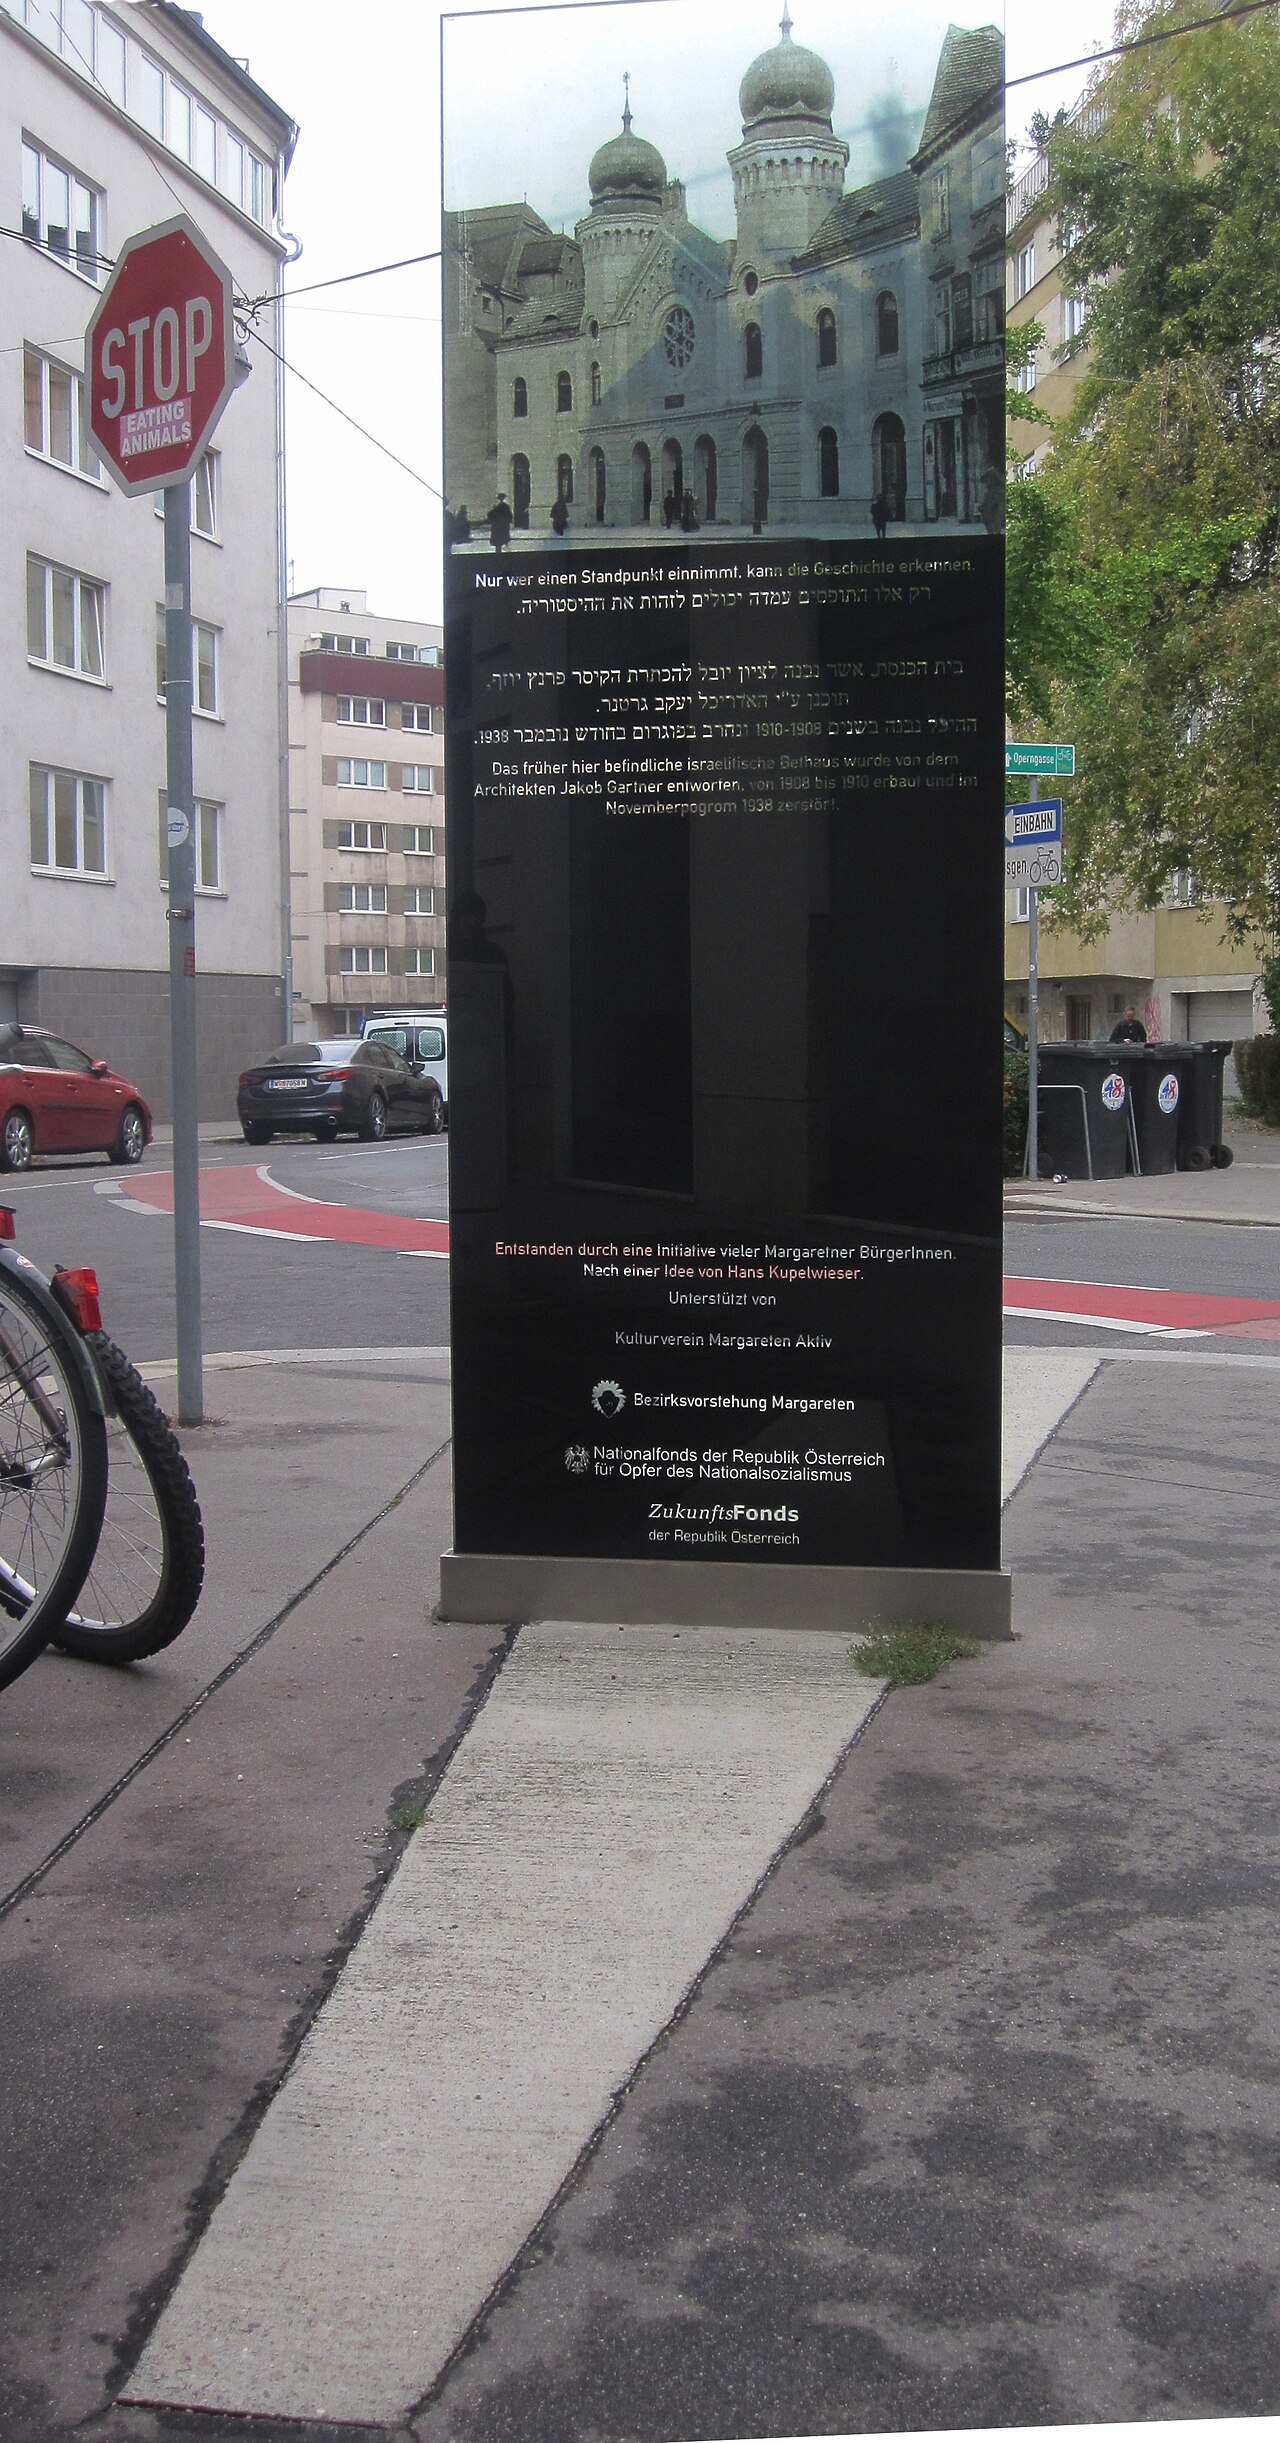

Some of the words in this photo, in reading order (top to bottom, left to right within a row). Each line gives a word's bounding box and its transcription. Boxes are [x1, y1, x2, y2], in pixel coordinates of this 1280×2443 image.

[101, 296, 213, 419] STOP
[127, 400, 184, 432] EATING
[120, 421, 191, 456] ANIMALS
[475, 573, 503, 588] Nur
[507, 574, 533, 586] wer
[538, 570, 577, 585] einen
[581, 566, 665, 586] Standpunkt
[747, 564, 783, 578] kann
[788, 562, 809, 576] die
[814, 559, 895, 576] Geschichte
[899, 559, 975, 572] erkennen.
[611, 596, 634, 611] את
[639, 590, 685, 609] לזהות
[692, 588, 742, 608] יכולים
[749, 590, 791, 607] עמדה
[909, 586, 932, 604] רק
[516, 596, 605, 614] ההיסטוריה.
[572, 670, 621, 688] הקיסר
[627, 663, 692, 684] להכתרת
[698, 662, 732, 681] יובל
[738, 660, 778, 683] לציון
[784, 664, 820, 678] נבנה
[827, 662, 863, 678] אשר
[527, 671, 566, 690] פרנץ
[596, 697, 649, 712] גרטנר.
[654, 695, 692, 714] יעקב
[698, 691, 768, 711] האדריכל
[513, 728, 569, 743] נובמבר
[575, 726, 626, 742] בחודש
[829, 720, 879, 735] בשנים
[886, 719, 921, 734] נבנה
[493, 762, 519, 776] Das
[523, 761, 568, 775] früher
[572, 760, 600, 774] hier
[605, 758, 683, 773] befindliche
[687, 756, 775, 771] israelitische
[780, 755, 839, 769] Bethaus
[844, 753, 891, 767] wurde
[896, 755, 921, 767] von
[927, 752, 959, 766] dem
[1013, 752, 1055, 767] Operngasse
[474, 782, 555, 797] Architekten
[560, 780, 603, 795] Jakob
[607, 779, 663, 794] Gartner
[750, 780, 775, 791] von
[780, 776, 810, 790] 1908
[815, 776, 836, 789] bis
[842, 775, 869, 789] 1910
[926, 773, 954, 787] und
[606, 800, 737, 817] Novemberpogrom
[742, 798, 773, 813] 1938
[1014, 811, 1053, 834] EINBAHN
[495, 1242, 573, 1256] Entstanden
[578, 1242, 618, 1257] durch
[623, 1243, 653, 1257] eine
[657, 1243, 716, 1258] Initiative
[720, 1244, 760, 1258] vieler
[765, 1245, 855, 1261] Margaretner
[860, 1245, 957, 1262] BürgerInnen.
[584, 1263, 620, 1278] Nach
[624, 1264, 661, 1278] einer
[664, 1264, 694, 1279] Idee
[698, 1267, 723, 1279] von
[728, 1265, 764, 1280] Hans
[769, 1265, 864, 1282] Kupelwieser.
[668, 1290, 748, 1306] Unterstützt
[752, 1295, 777, 1306] von
[615, 1331, 704, 1347] Kulturverein
[709, 1332, 791, 1350] Margareten
[795, 1334, 833, 1348] Aktiv
[634, 1393, 767, 1412] Bezirksvorstehung
[772, 1396, 856, 1413] Margareten
[593, 1446, 698, 1462] Nationalfonds
[702, 1448, 728, 1463] der
[732, 1449, 800, 1466] Republik
[804, 1448, 885, 1466] Österreich
[594, 1461, 615, 1476] für
[619, 1462, 662, 1479] Opfer
[666, 1464, 695, 1478] des
[699, 1464, 852, 1482] Nationalsozialismus
[648, 1529, 671, 1542] der
[674, 1529, 728, 1544] Republik
[731, 1528, 800, 1545] Österreich
